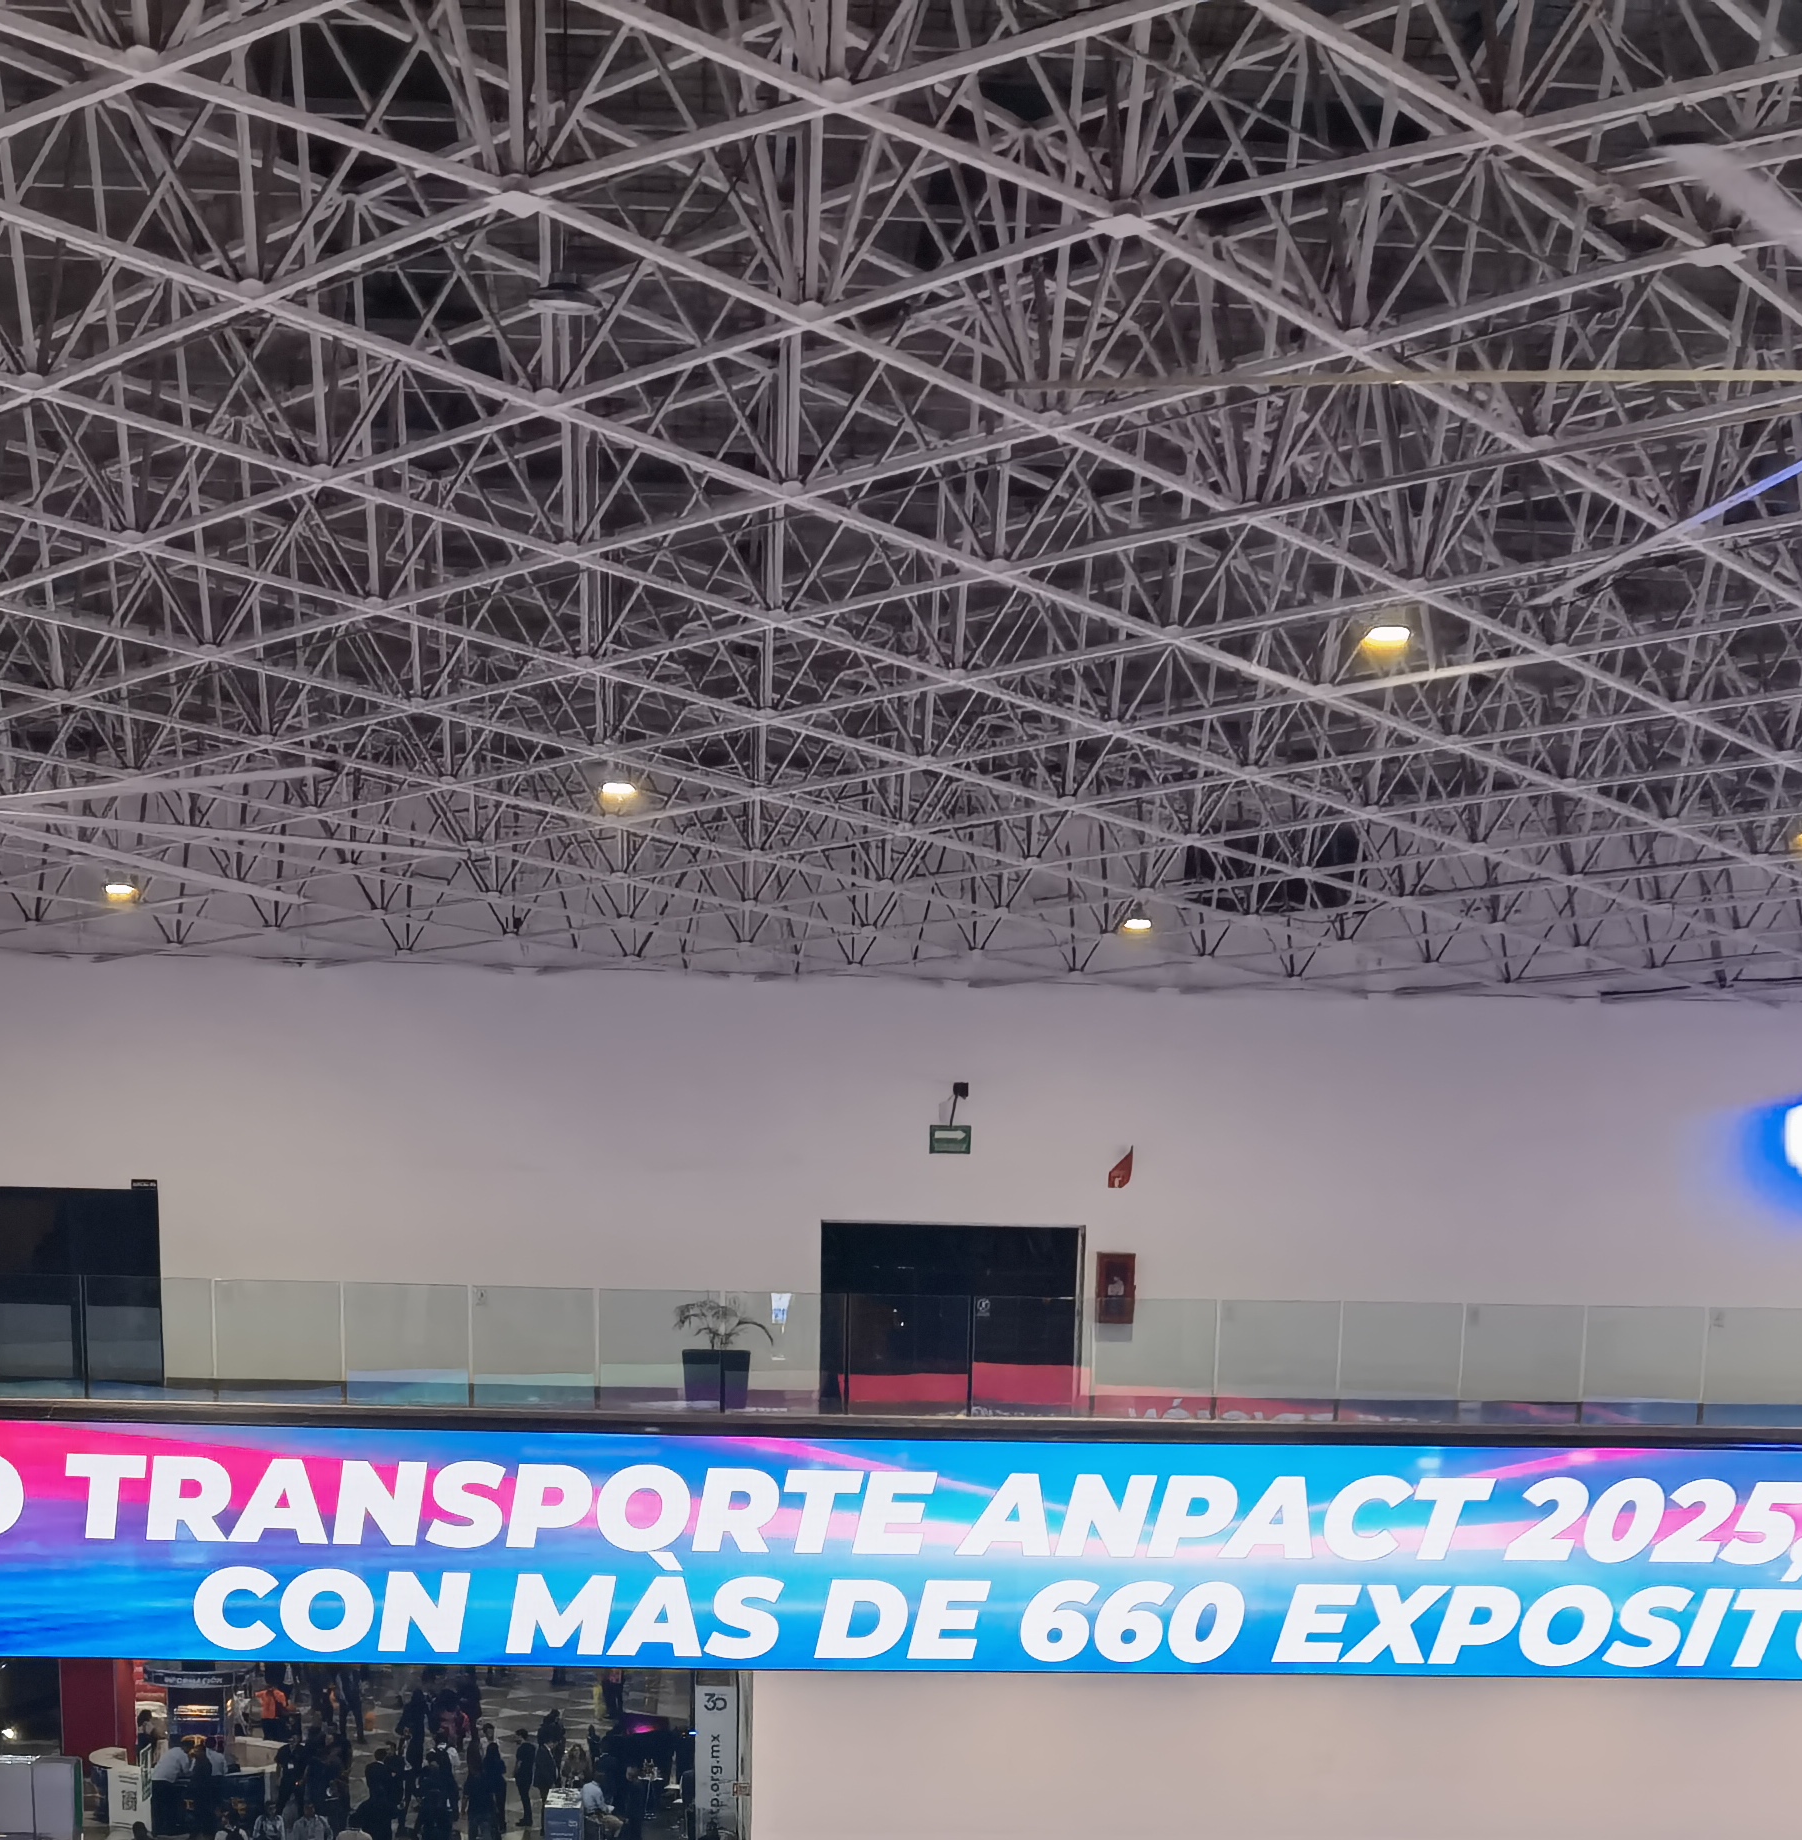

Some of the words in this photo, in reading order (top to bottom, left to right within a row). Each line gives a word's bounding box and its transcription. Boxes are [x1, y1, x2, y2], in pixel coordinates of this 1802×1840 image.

[63, 1452, 939, 1556] TRANSPORTE
[955, 1472, 1495, 1565] ANPACT
[194, 1565, 471, 1654] CON
[814, 1579, 1001, 1661] DE
[1018, 1580, 1246, 1665] 660
